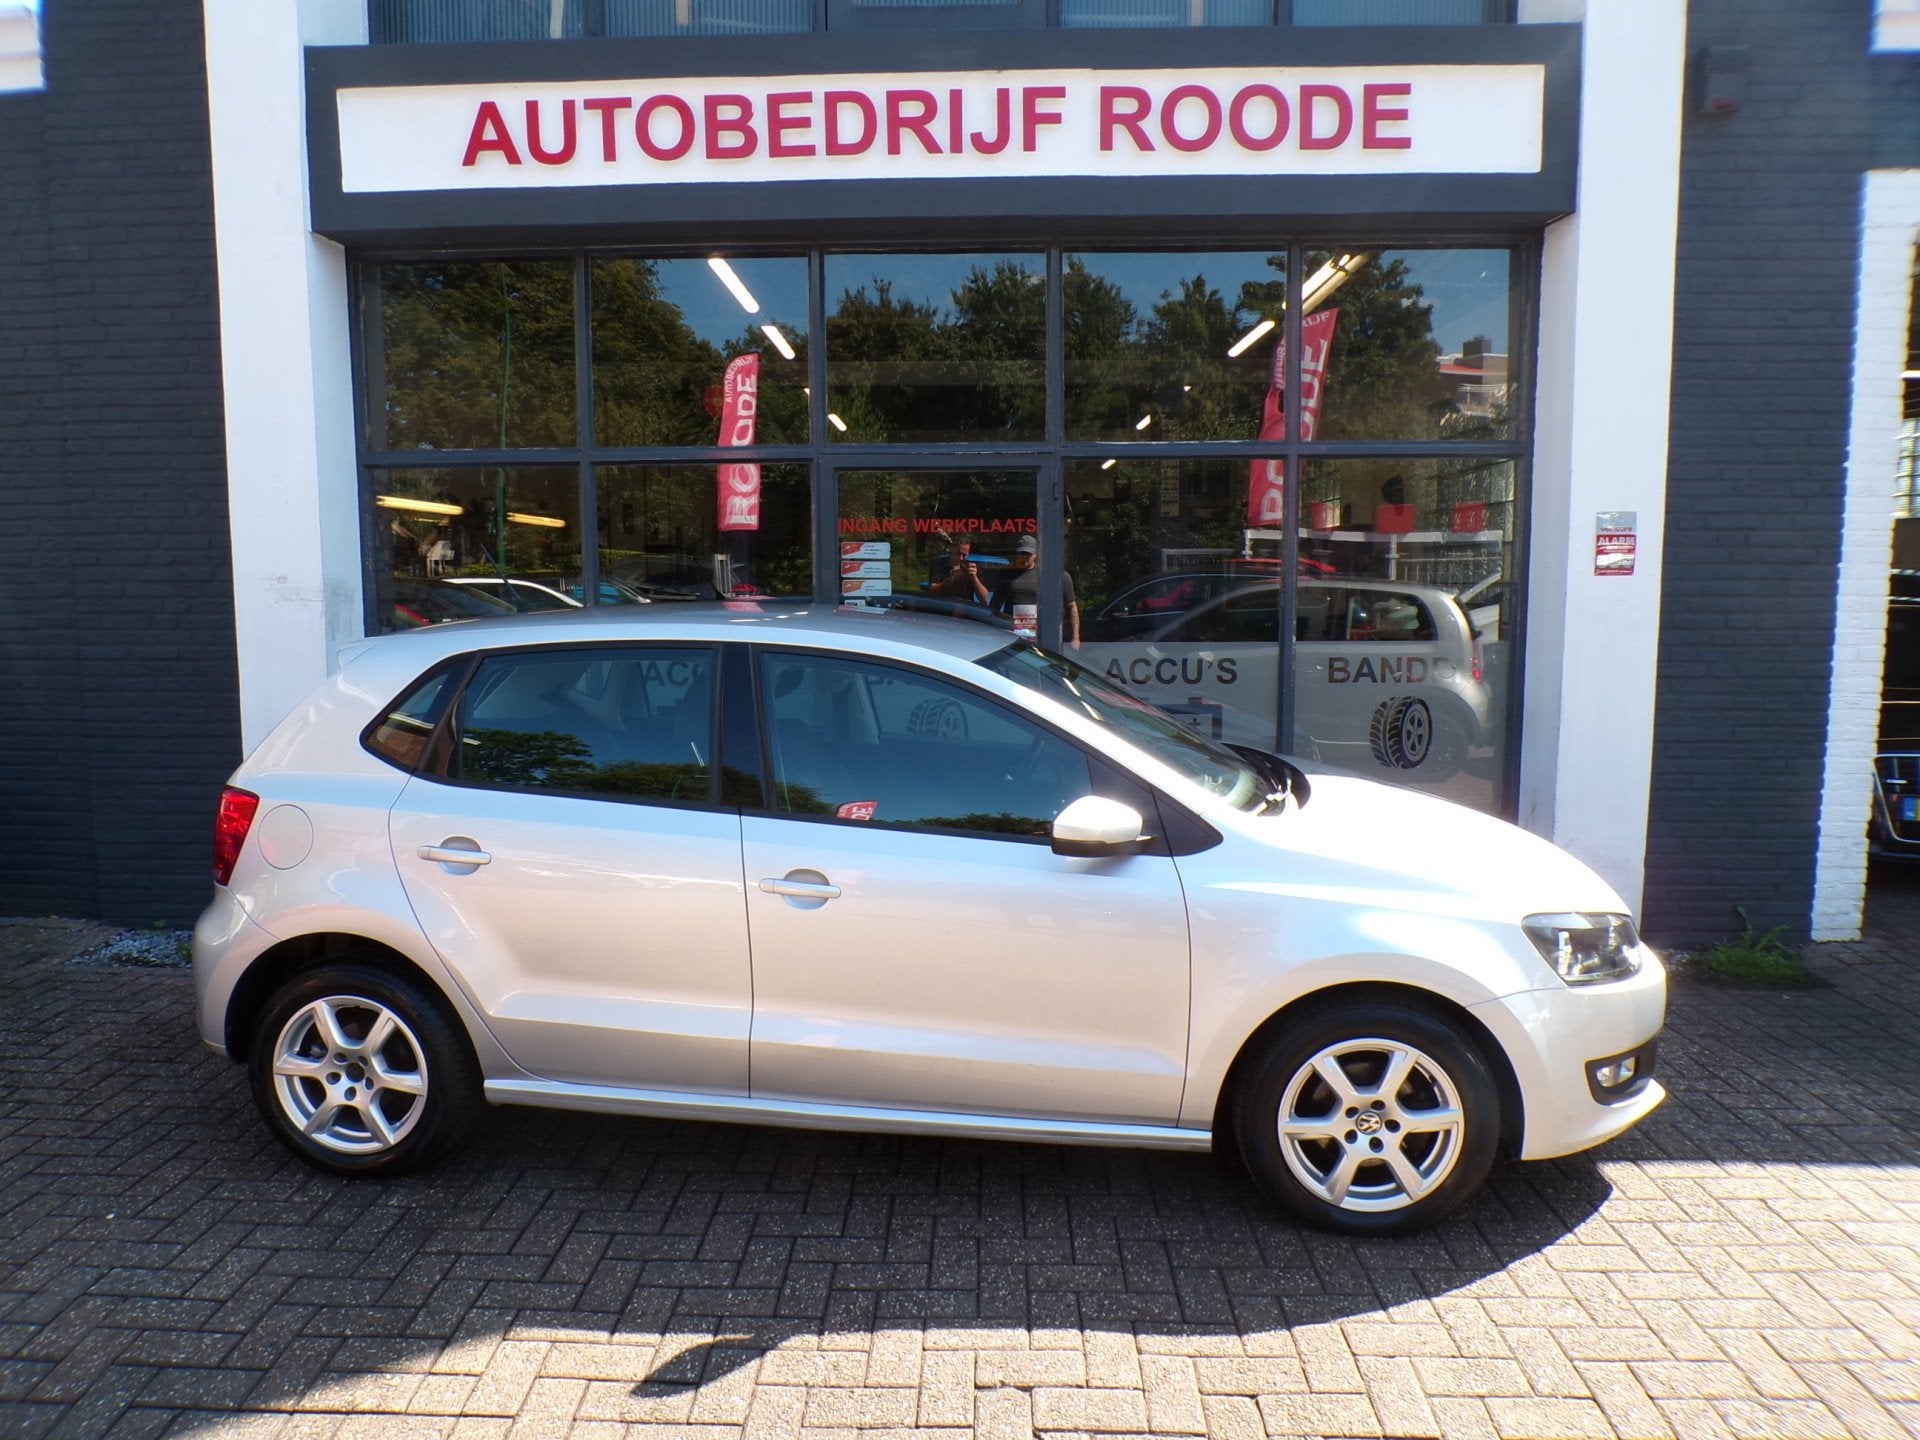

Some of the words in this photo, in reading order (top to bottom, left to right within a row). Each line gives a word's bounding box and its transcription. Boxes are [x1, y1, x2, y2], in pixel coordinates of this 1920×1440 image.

[461, 86, 1067, 167] AUTOBEDRIJF
[1099, 83, 1413, 152] ROODE
[727, 374, 759, 524] ROODE
[838, 518, 908, 533] INGANG
[913, 518, 1038, 533] WERKPLAATS
[1598, 536, 1635, 544] ALARM
[1105, 657, 1238, 685] ACCU'S
